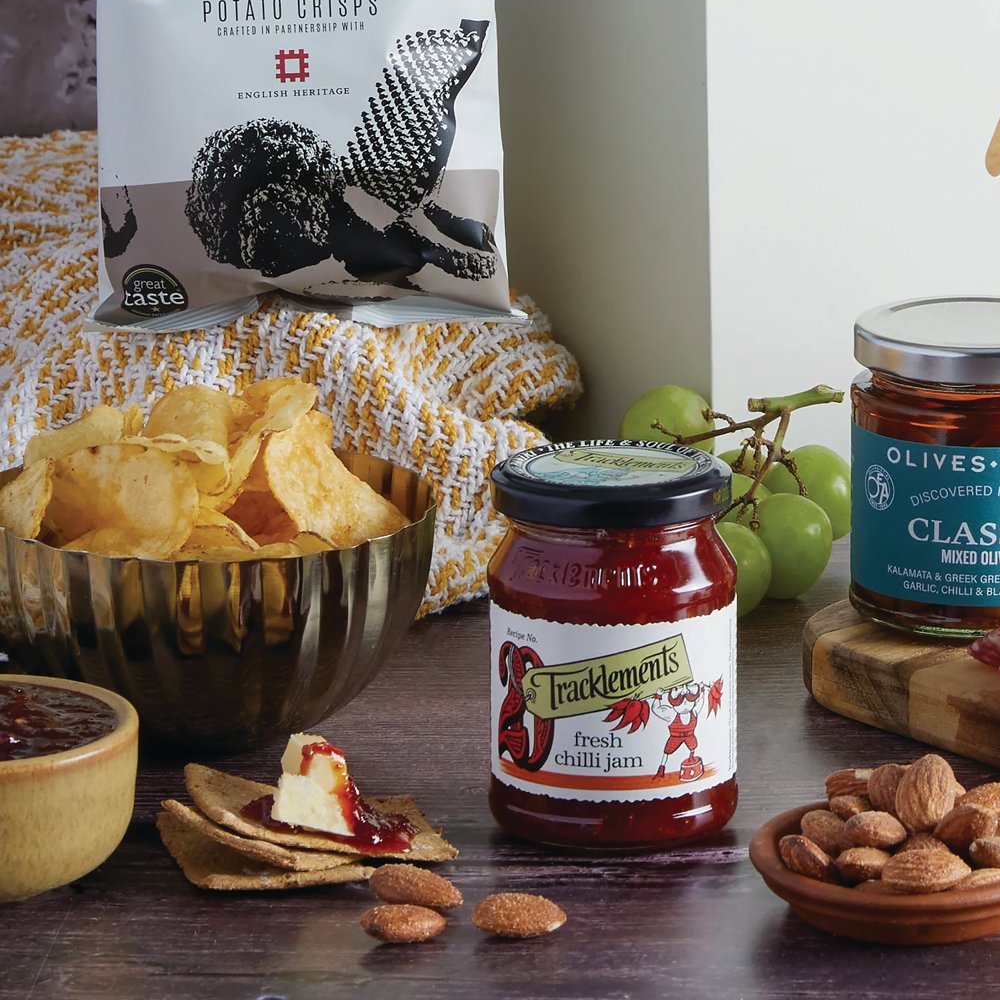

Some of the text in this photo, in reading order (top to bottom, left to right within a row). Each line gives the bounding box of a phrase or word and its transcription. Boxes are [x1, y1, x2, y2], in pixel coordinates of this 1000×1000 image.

[217, 21, 365, 37] CRAFTED IN PARTNERSHIP WITH
[237, 87, 350, 100] ENGLISH HERITAGE
[133, 279, 167, 293] great
[124, 290, 185, 306] taste
[580, 439, 616, 447] LIFE
[619, 439, 633, 447] &
[636, 440, 674, 451] SOUL
[910, 485, 993, 507] DISCOVERED
[941, 549, 978, 565] MIXED
[887, 564, 933, 580] KALAMATA
[934, 572, 942, 581] &
[944, 573, 978, 584] GREEK
[903, 580, 939, 595] GARLIC,
[941, 585, 973, 596] CHILLI
[975, 587, 983, 596] &
[506, 627, 538, 644] Recipe No.
[530, 640, 680, 711] Tracklements
[573, 731, 623, 749] fresh
[554, 750, 643, 773] chilli jam
